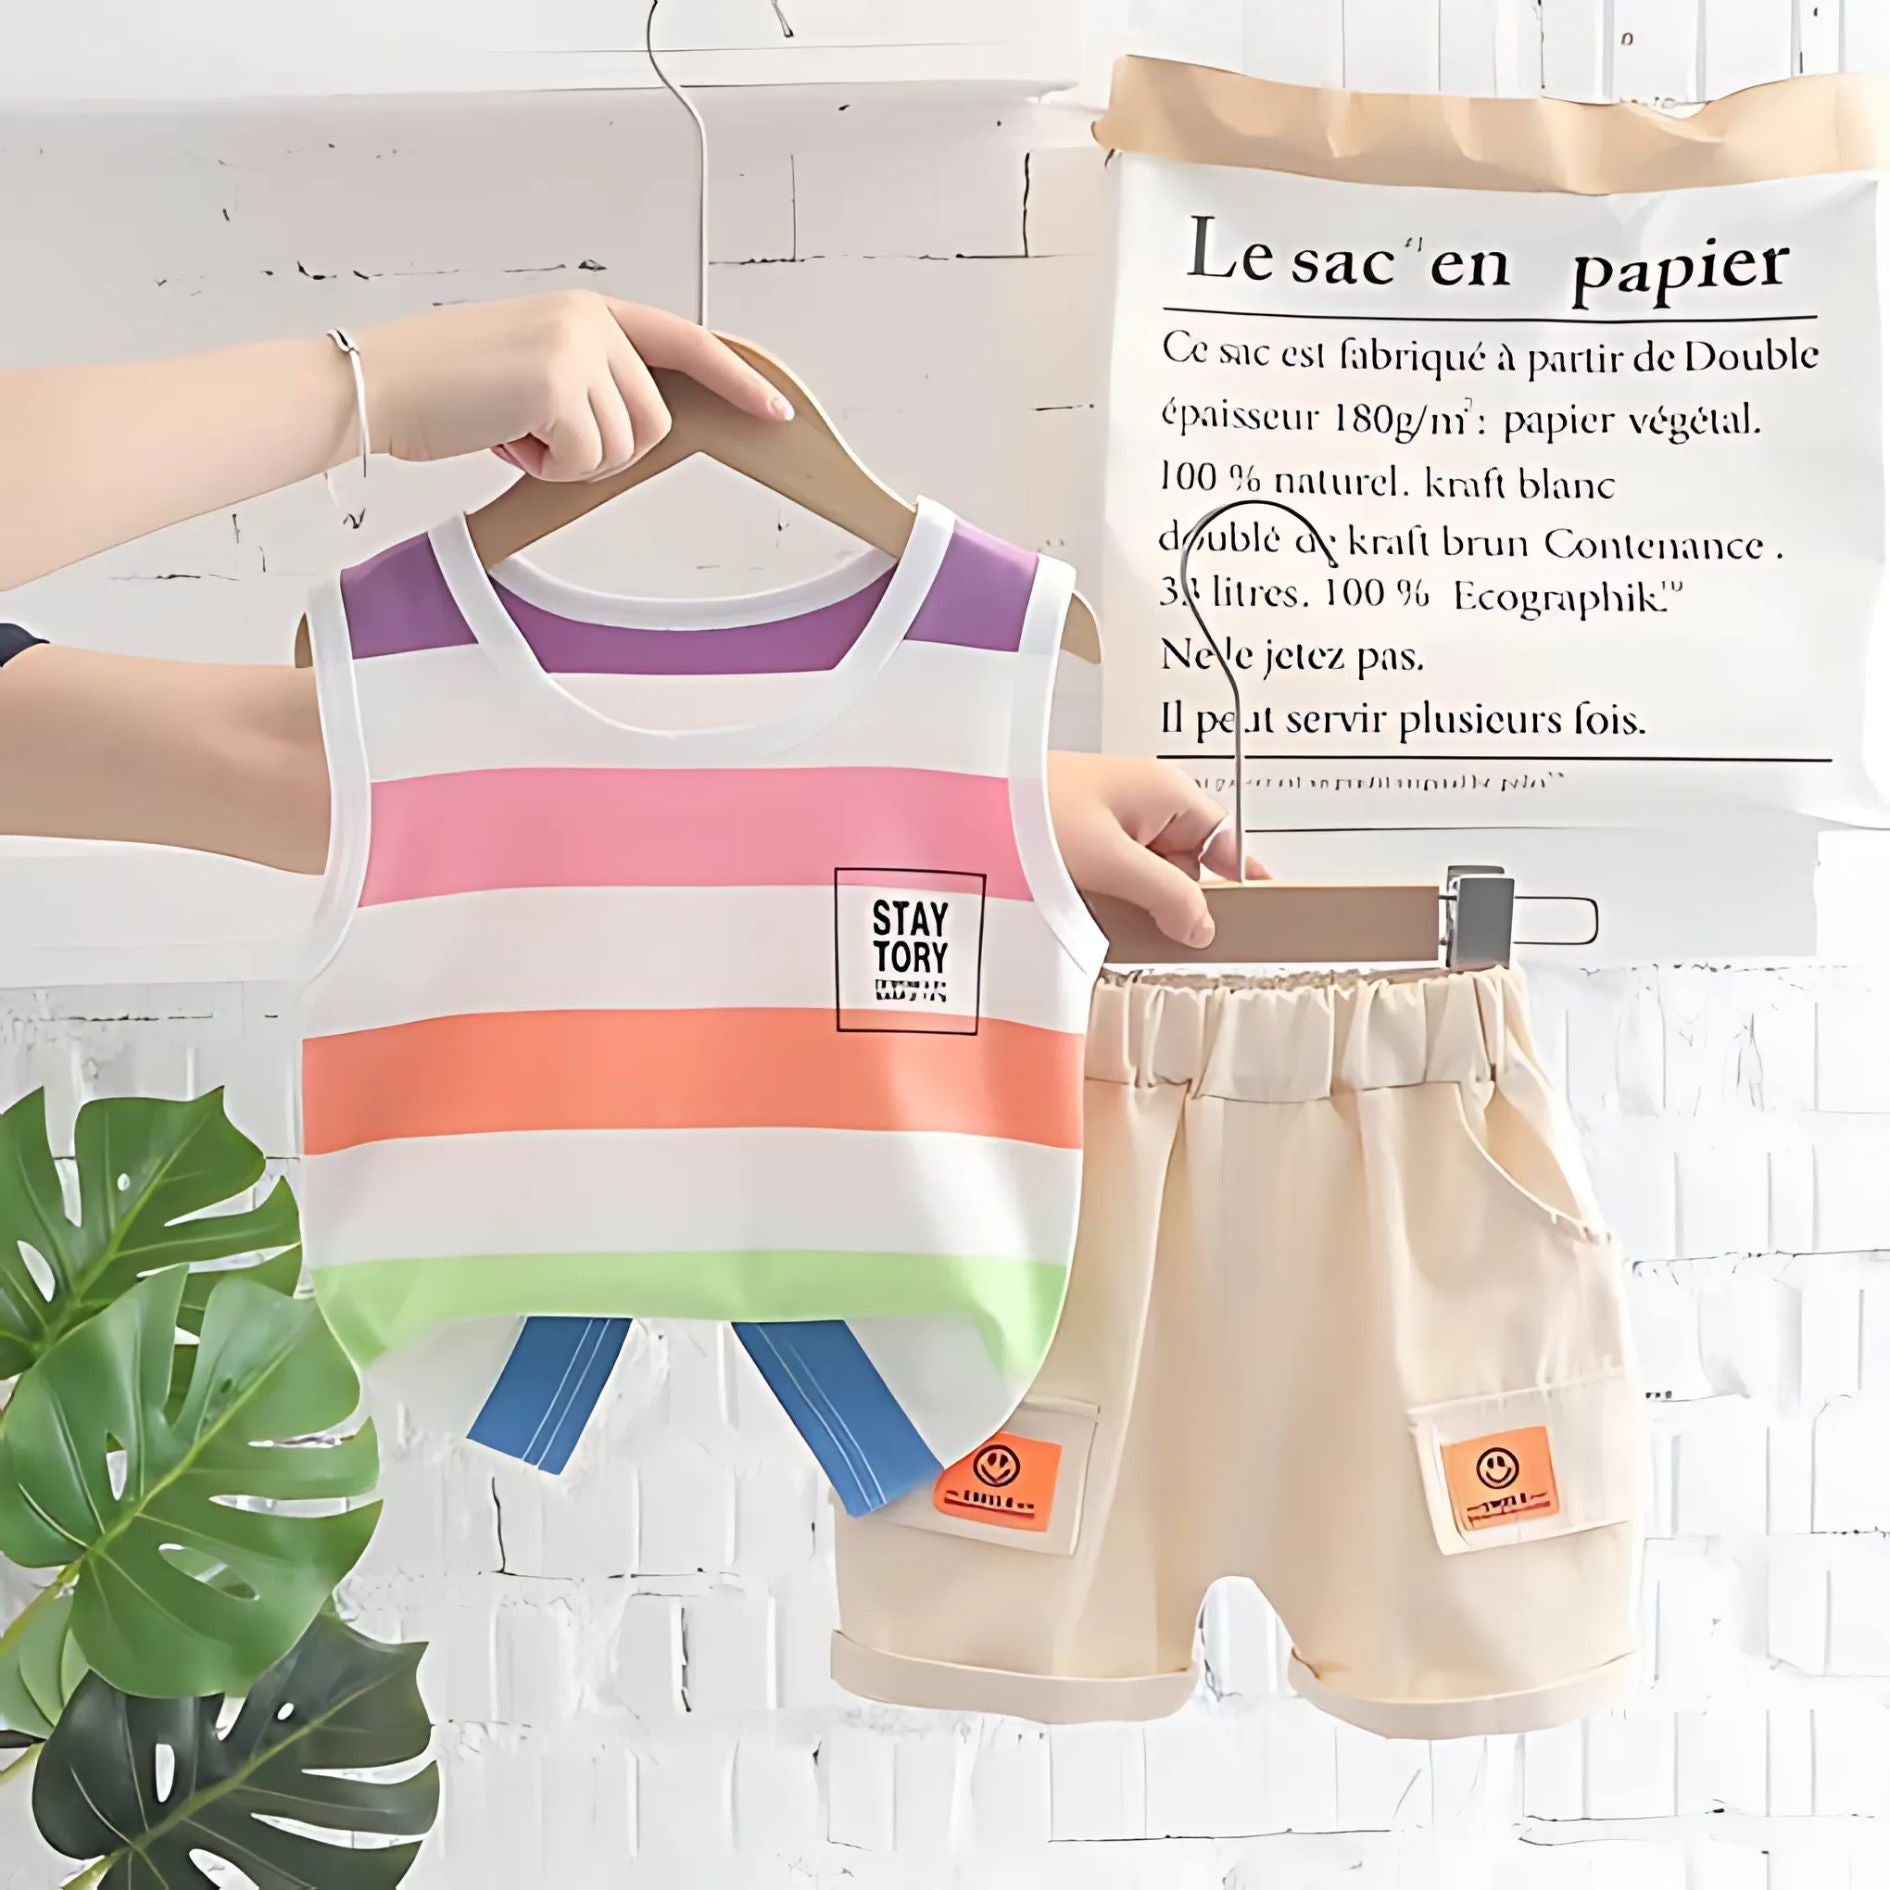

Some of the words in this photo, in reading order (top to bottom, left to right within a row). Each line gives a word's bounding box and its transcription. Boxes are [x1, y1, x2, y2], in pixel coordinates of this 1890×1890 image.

[1186, 214, 1274, 281] Le
[1291, 249, 1395, 286] sac
[1431, 251, 1511, 287] en
[1571, 237, 1791, 310] papier
[1162, 329, 1209, 364] Ce
[1219, 343, 1271, 367] sac
[1281, 342, 1325, 369] est
[1340, 336, 1487, 382] fabriqué
[1497, 342, 1516, 372] à
[1528, 343, 1625, 383] partir
[1631, 339, 1677, 373] de
[1685, 336, 1820, 372] Double
[1161, 396, 1320, 437] épaisseur
[1504, 403, 1616, 445] papier
[1628, 400, 1761, 446] végétal.
[1161, 459, 1217, 492] 100
[1229, 463, 1261, 493] %
[1275, 463, 1409, 497] naturel.
[1425, 465, 1506, 500] kraft
[1519, 466, 1616, 500] blanc
[1348, 523, 1430, 557] kraft
[1442, 524, 1529, 558] brun
[1213, 573, 1309, 609] litres.
[1326, 577, 1385, 607] 100
[1396, 578, 1430, 607] %
[1160, 637, 1213, 670] Ne
[1225, 635, 1254, 670] le
[1262, 638, 1345, 681] jetez
[1357, 647, 1424, 681] pas.
[1162, 699, 1183, 733] Il
[1285, 701, 1388, 734] servir
[1399, 699, 1562, 745] plusieurs
[1575, 699, 1647, 736] fois.
[872, 899, 949, 937] STAY
[872, 940, 949, 974] TORY
